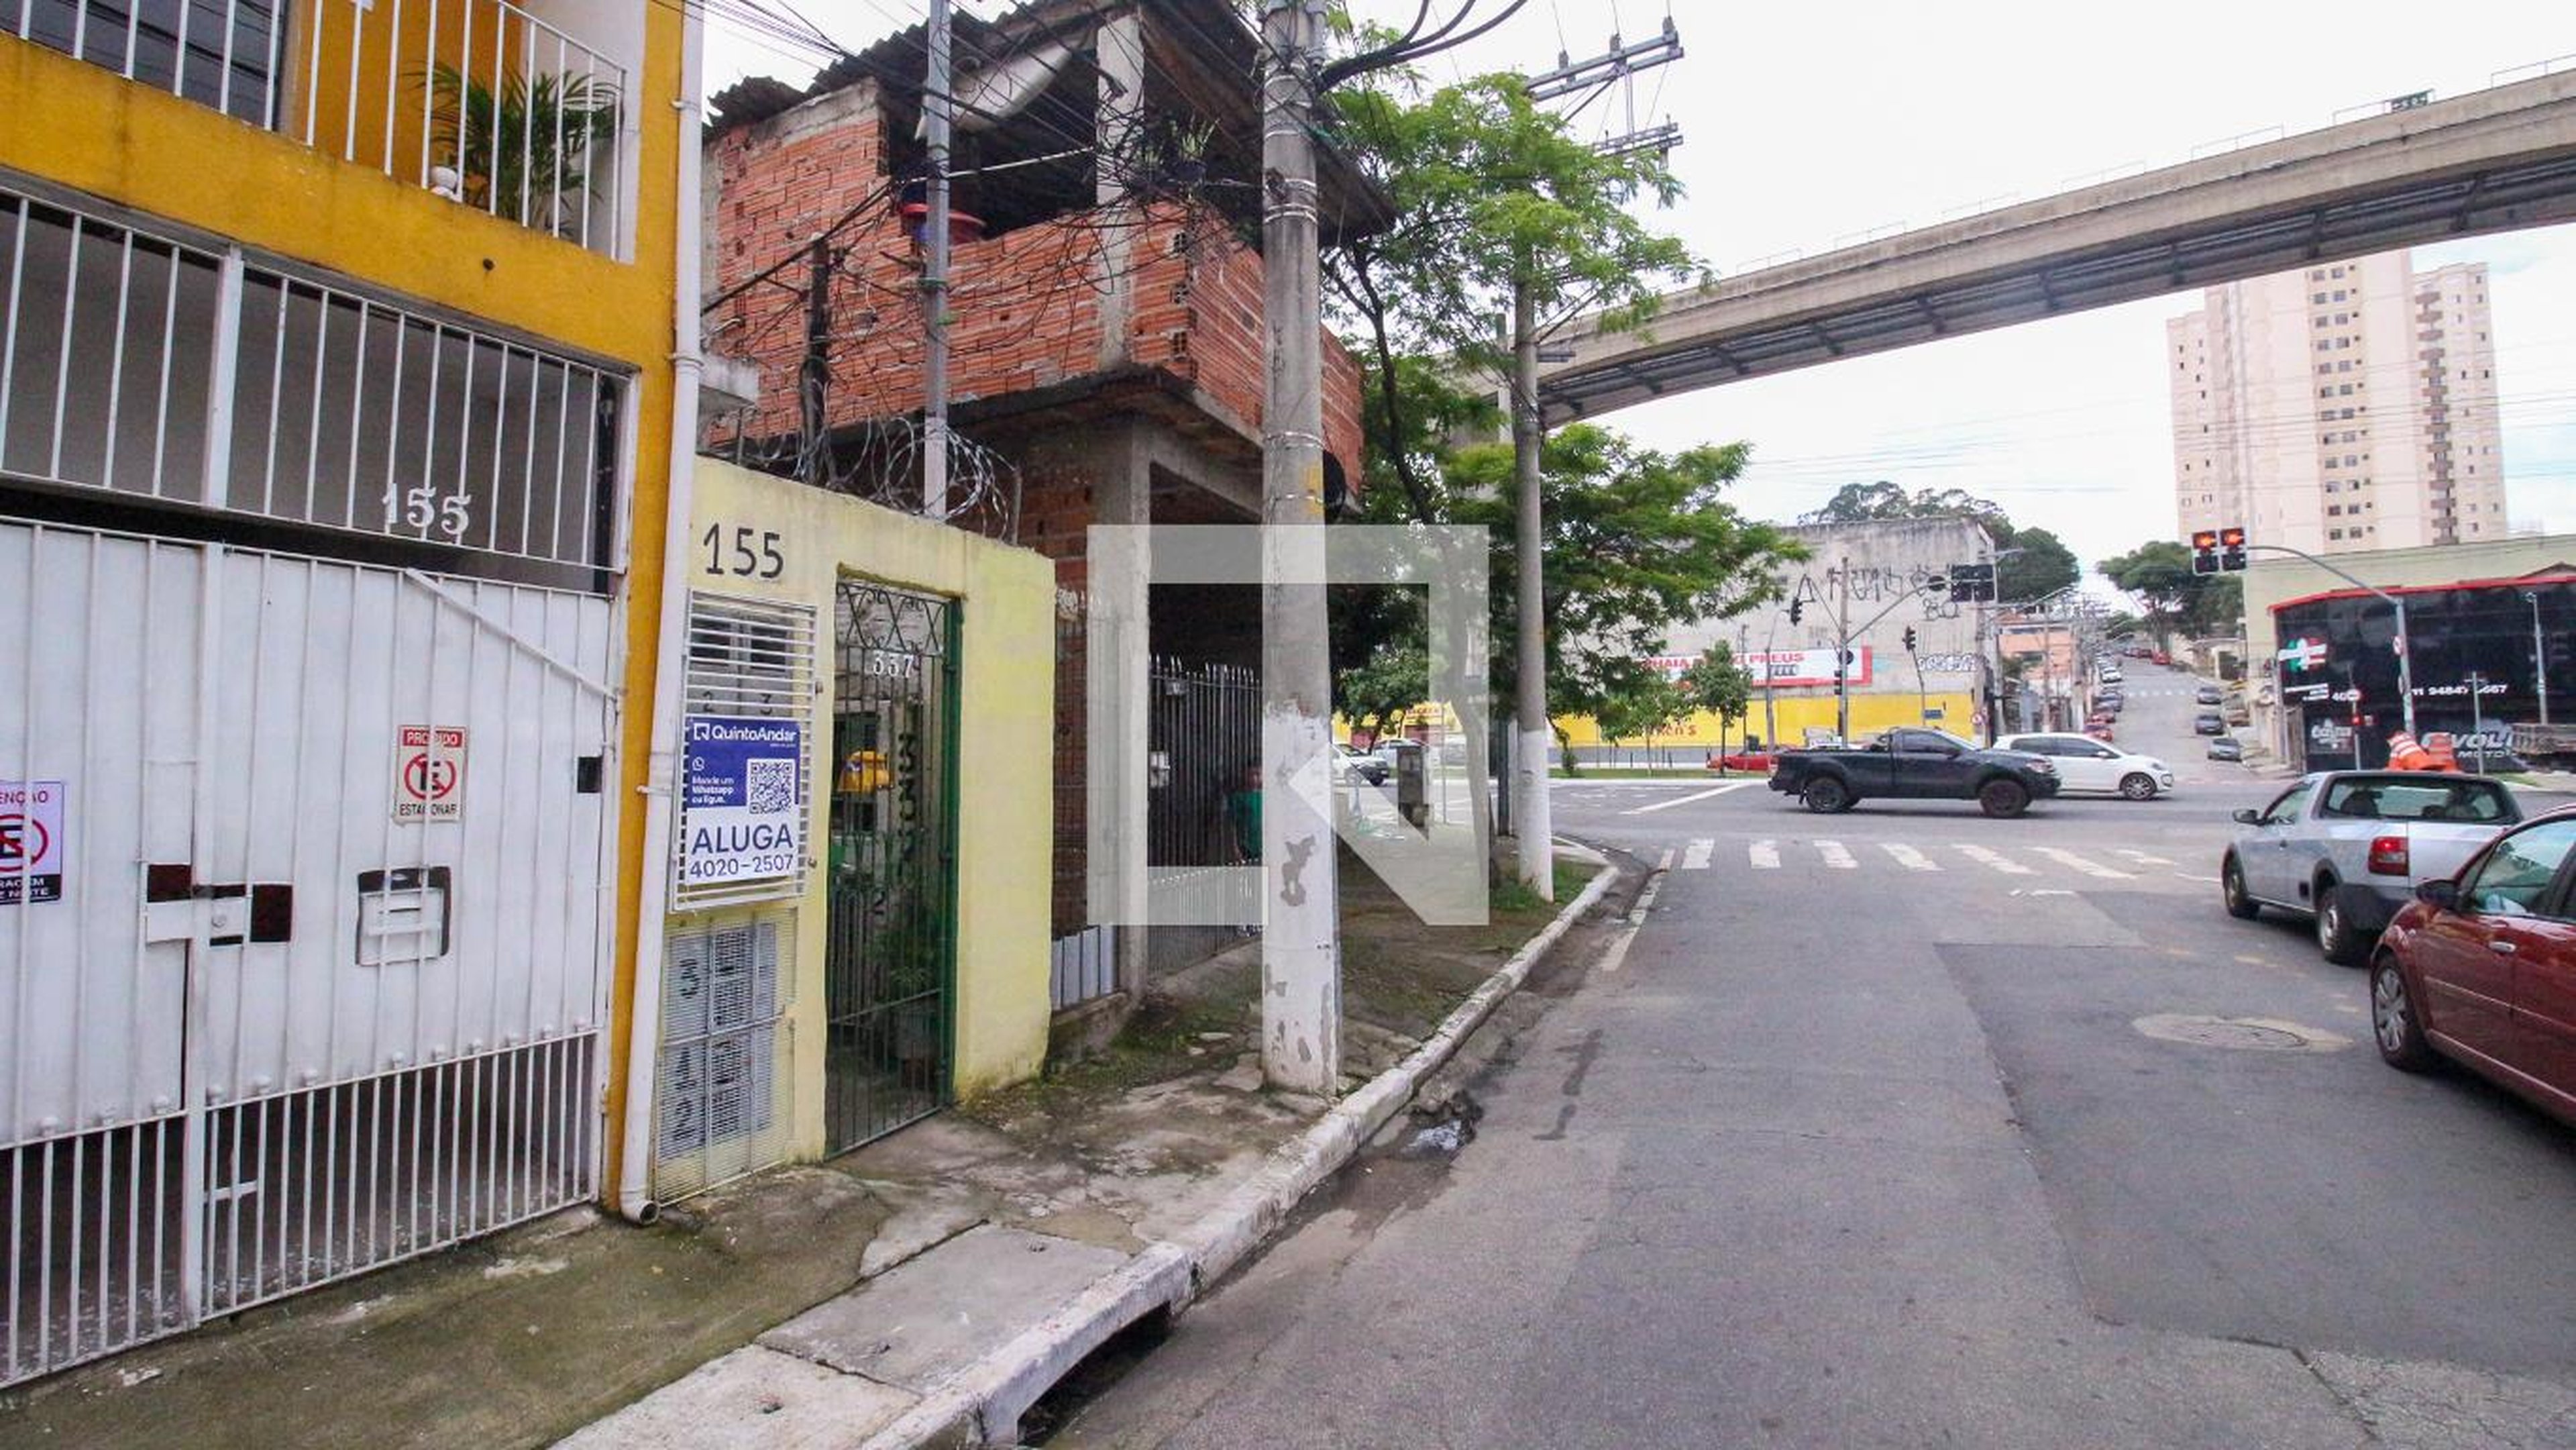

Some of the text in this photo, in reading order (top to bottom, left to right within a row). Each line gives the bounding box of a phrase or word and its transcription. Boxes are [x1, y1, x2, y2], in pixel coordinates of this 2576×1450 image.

[382, 482, 472, 535] 155
[703, 522, 784, 578] 155
[711, 724, 797, 741] QuintoAndar
[691, 823, 794, 856] ALUGA
[690, 854, 794, 878] 4020-2507
